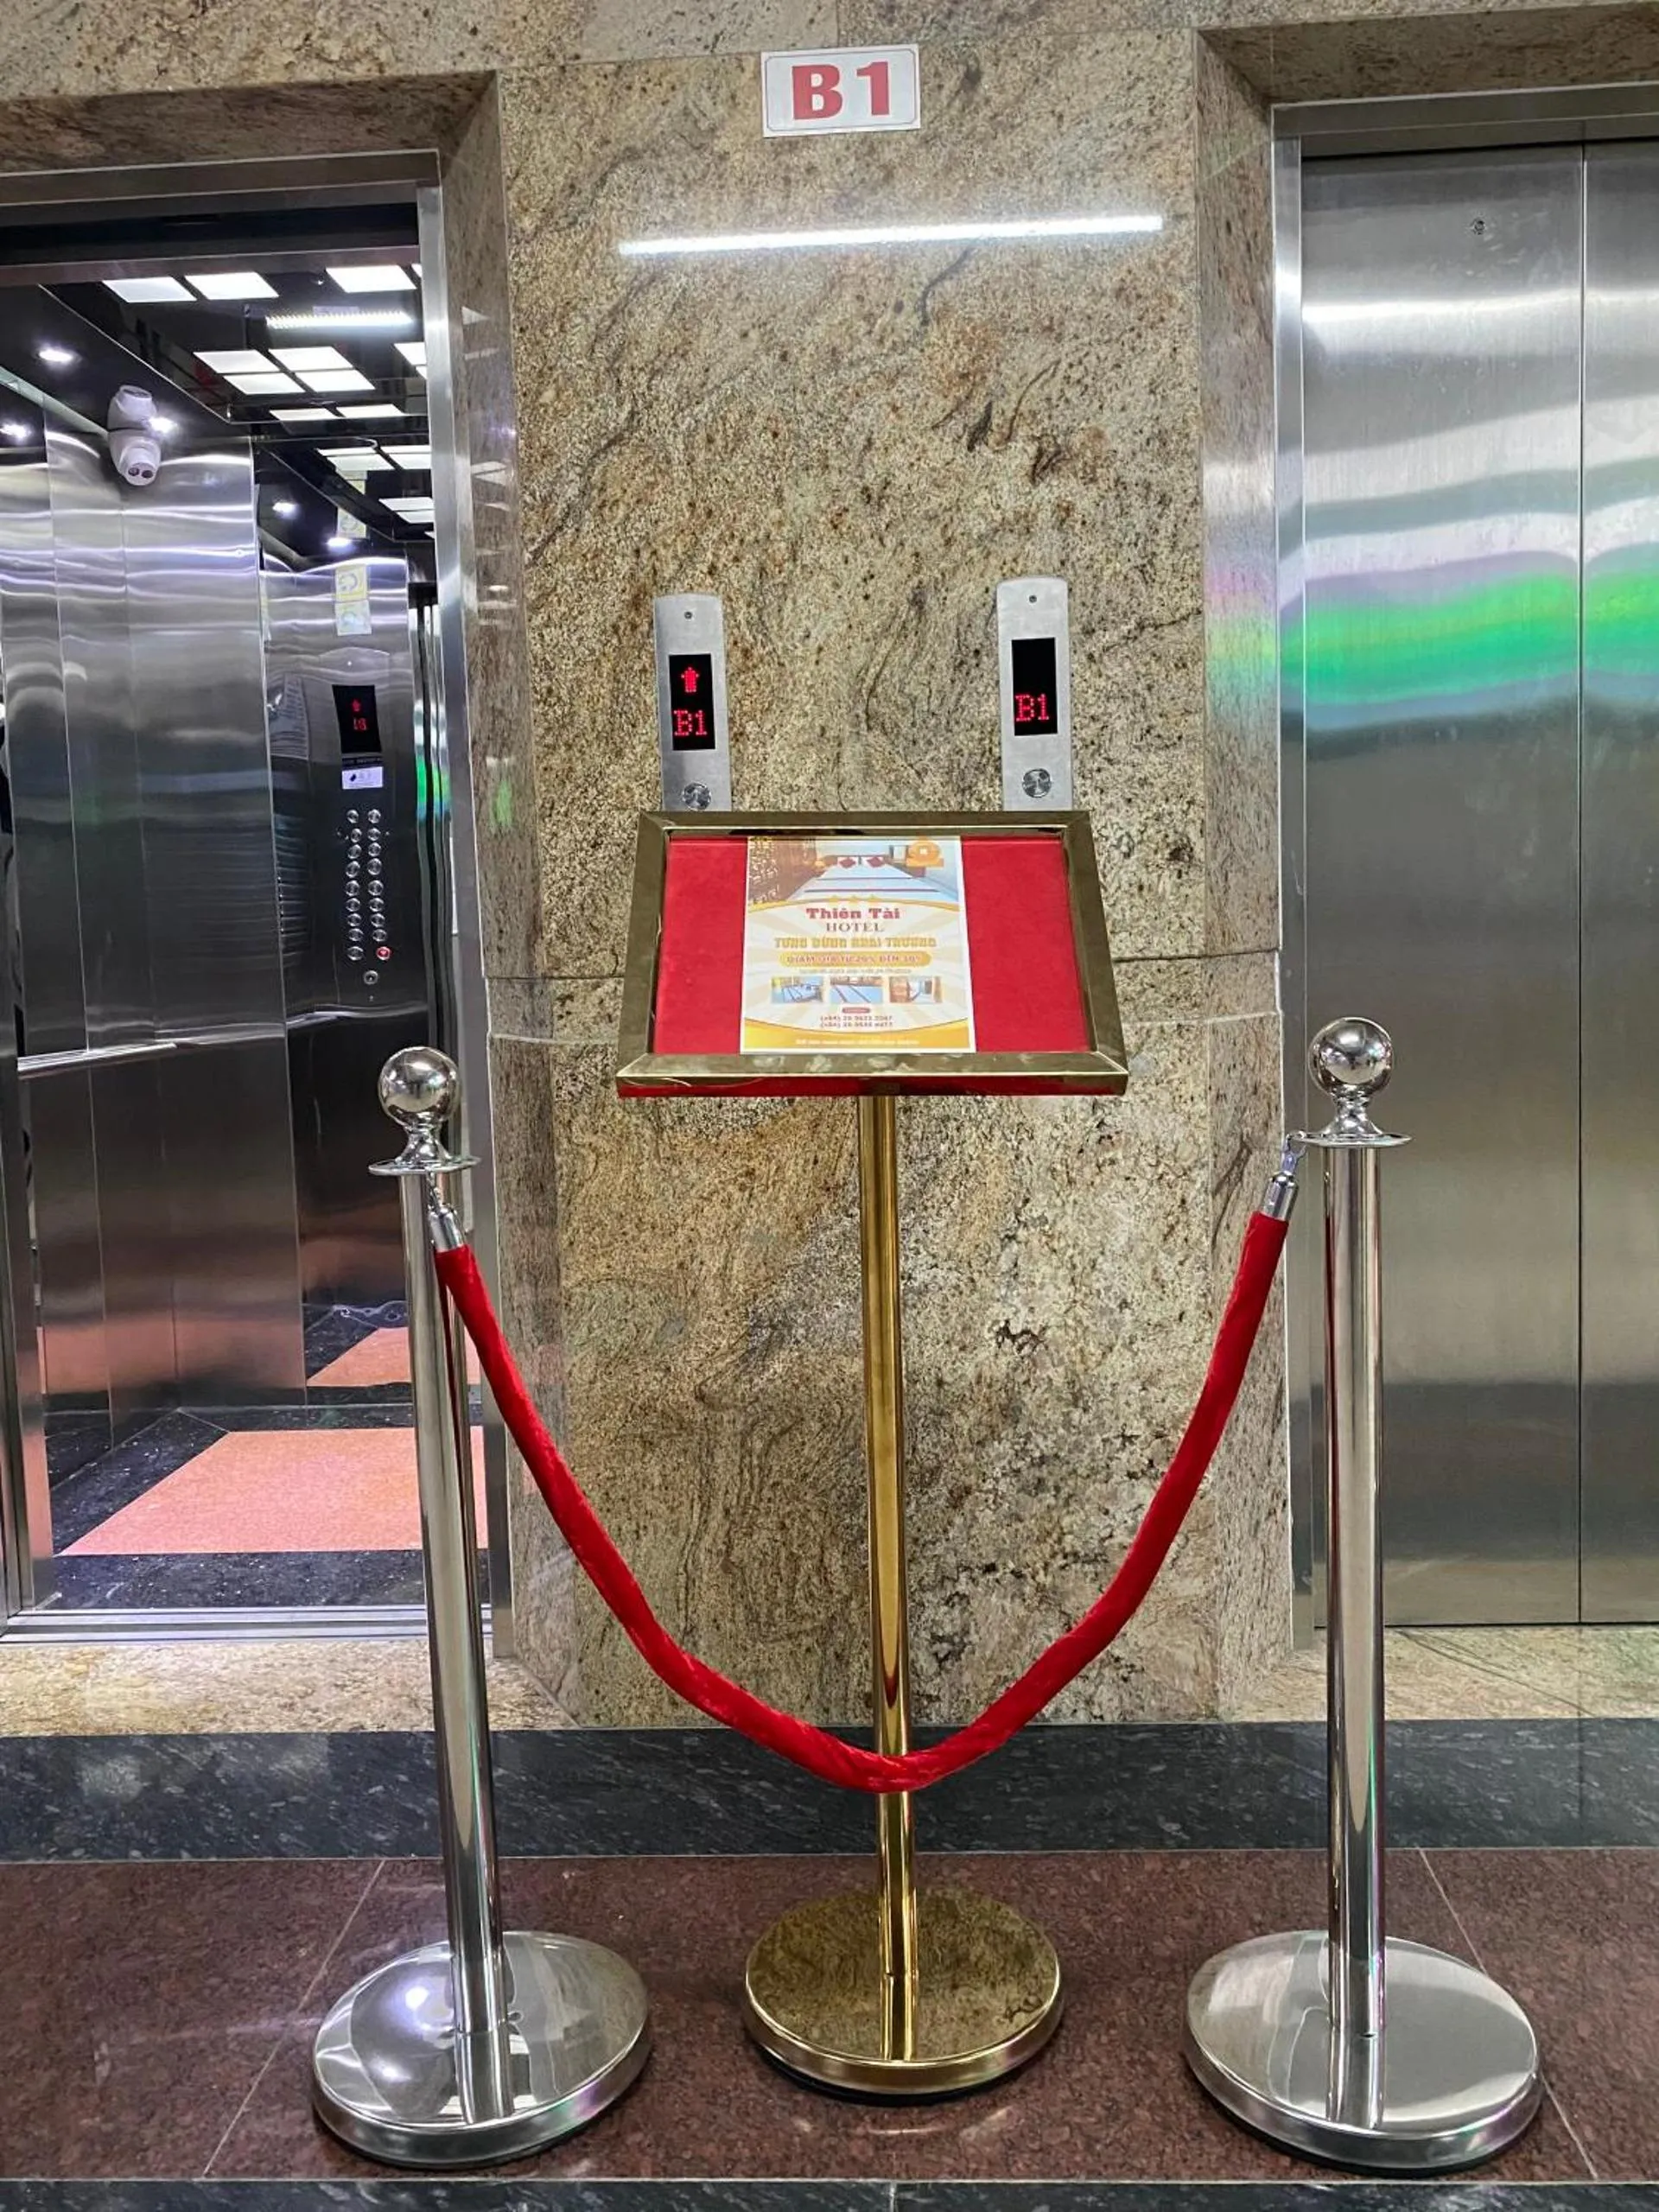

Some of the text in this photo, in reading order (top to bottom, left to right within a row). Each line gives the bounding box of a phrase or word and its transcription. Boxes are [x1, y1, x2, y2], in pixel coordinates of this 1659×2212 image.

[791, 61, 890, 120] B1
[1014, 693, 1050, 721] B1
[673, 709, 707, 736] B1
[805, 907, 900, 919] Thiên Tài
[826, 922, 884, 932] HOTEL
